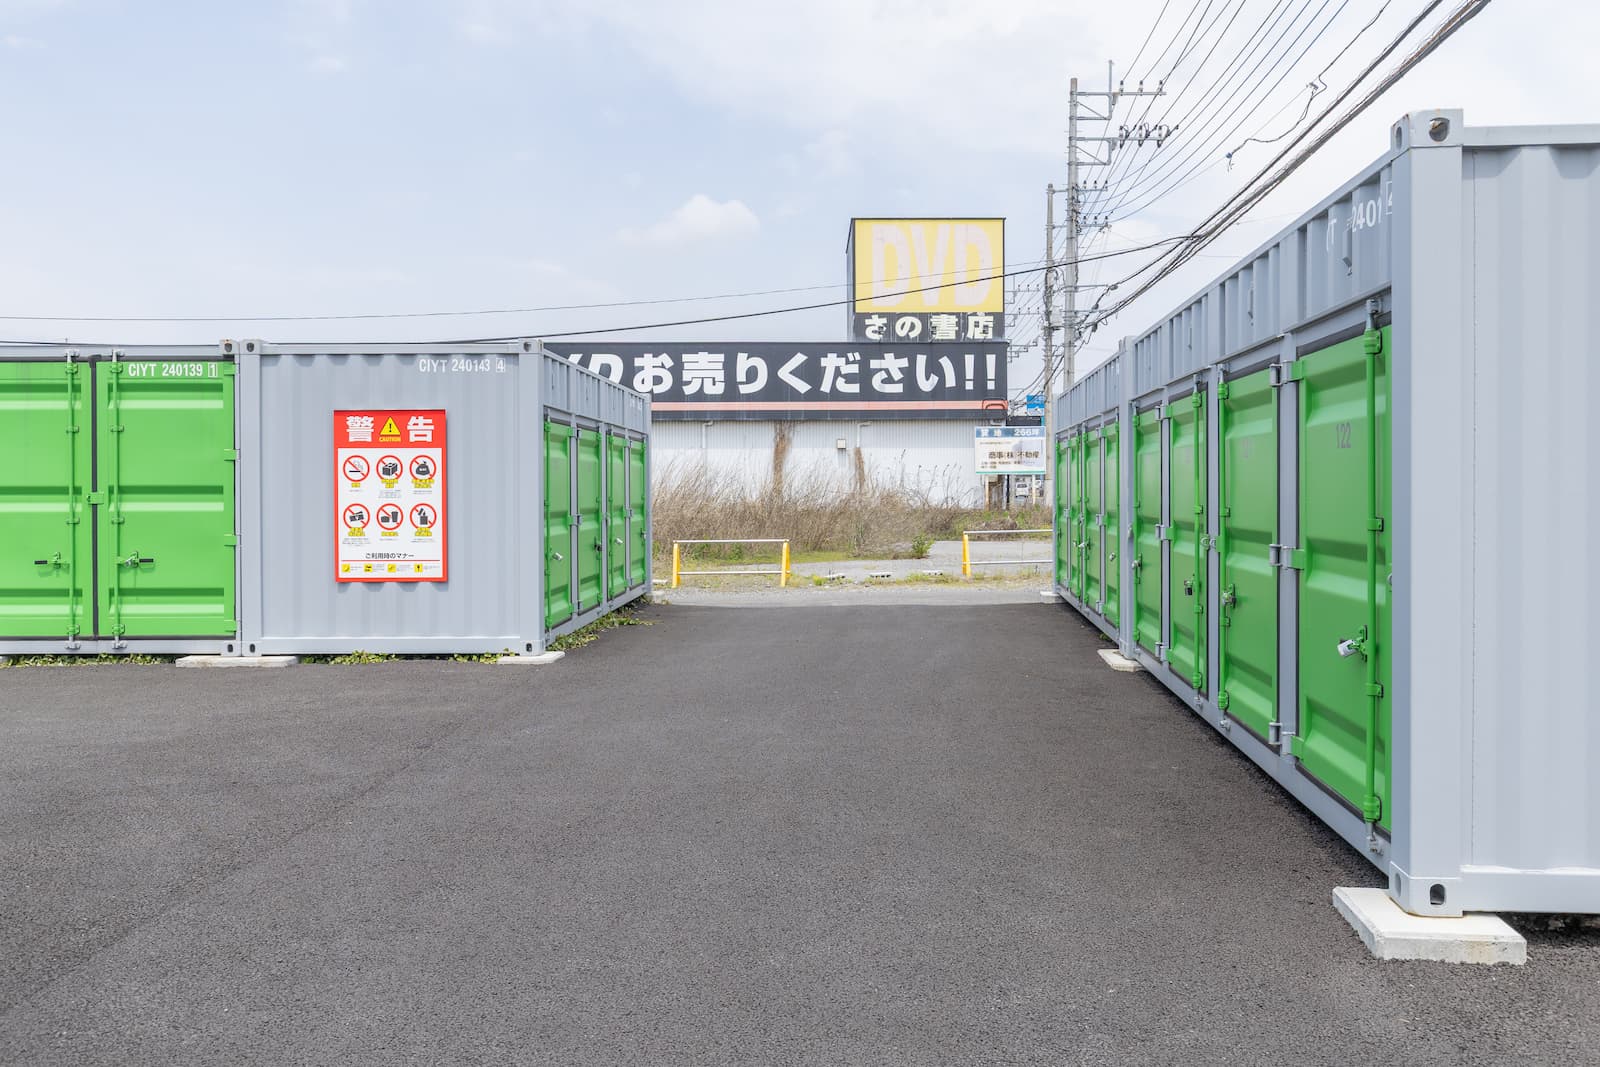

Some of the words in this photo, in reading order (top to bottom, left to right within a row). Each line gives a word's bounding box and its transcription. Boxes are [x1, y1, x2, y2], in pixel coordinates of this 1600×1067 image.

[871, 223, 993, 307] DVD
[864, 313, 994, 340] さの書店
[128, 363, 157, 377] CIYT
[162, 363, 203, 377] 240139
[419, 358, 448, 373] CIYT
[451, 358, 491, 372] 240143
[1335, 421, 1352, 449] 122
[365, 552, 415, 560] ご利用時のマナー
